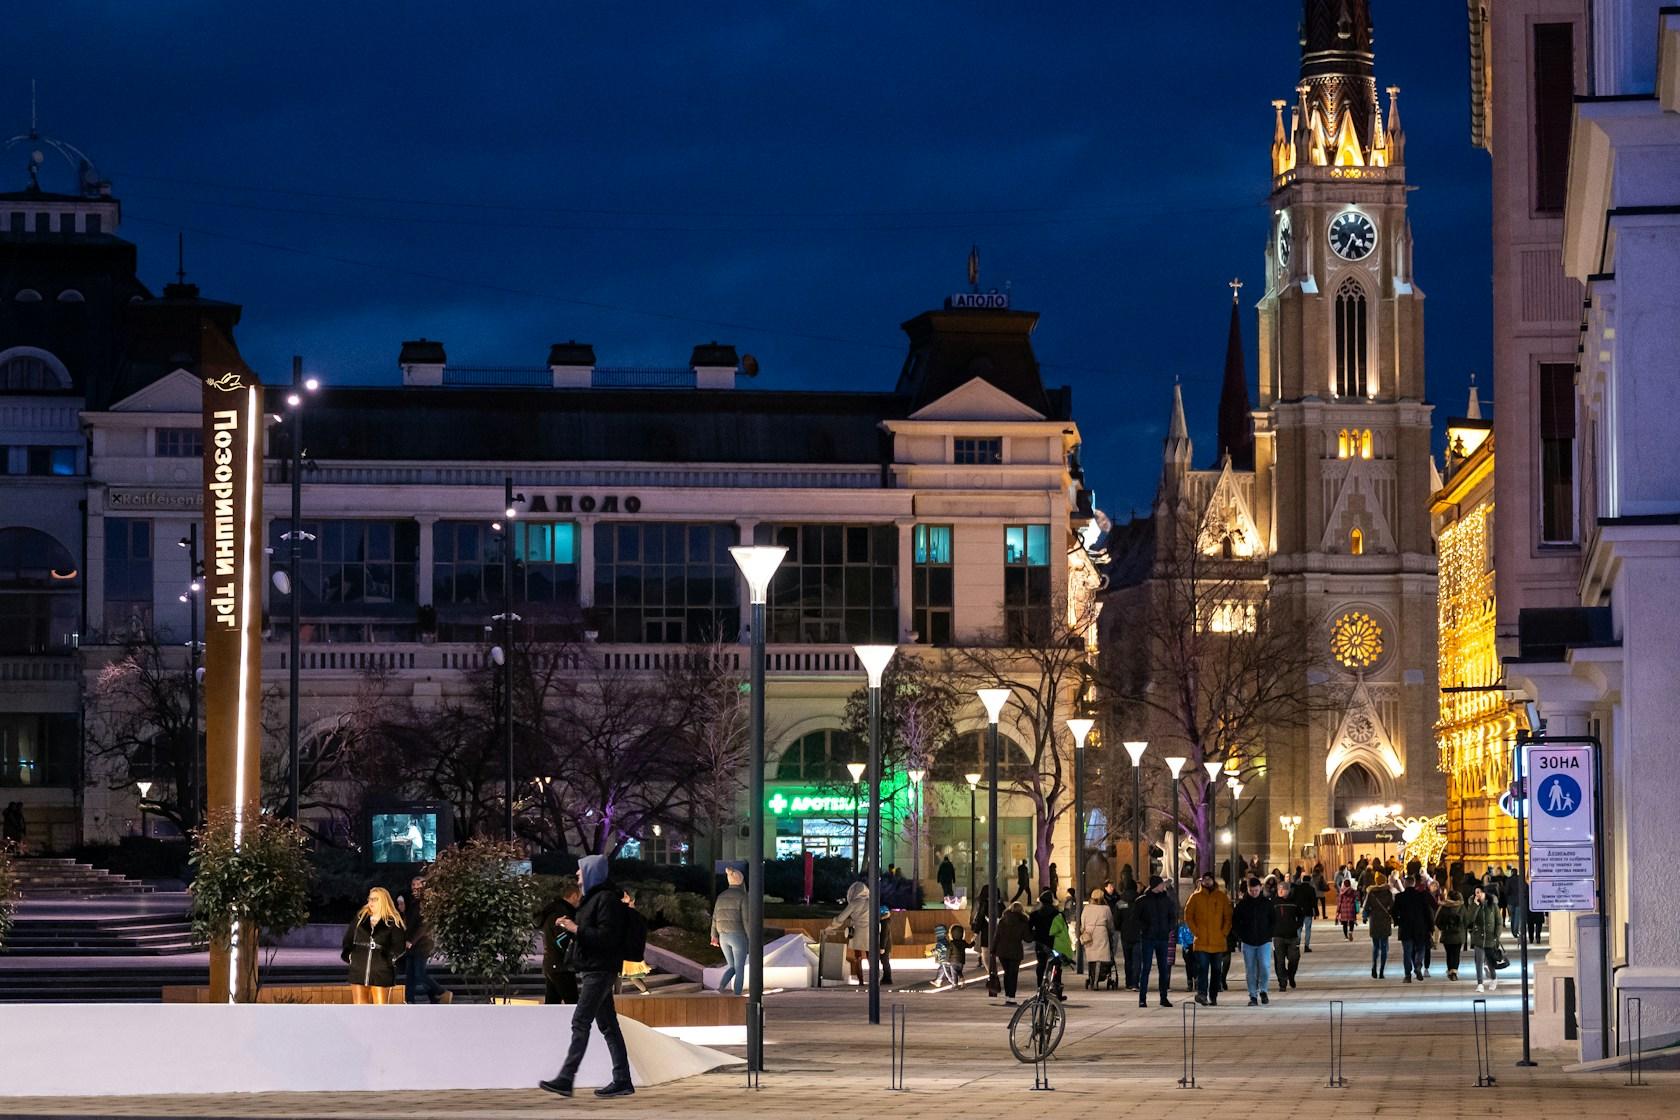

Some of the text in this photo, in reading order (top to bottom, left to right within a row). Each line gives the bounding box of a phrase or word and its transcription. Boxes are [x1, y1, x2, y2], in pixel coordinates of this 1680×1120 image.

[957, 295, 1005, 307] АПОЛО
[122, 491, 194, 505] Raiffeisen
[528, 495, 642, 513] АПОЛО
[209, 409, 238, 627] Позоришни трг
[1539, 756, 1580, 769] ЗОНА
